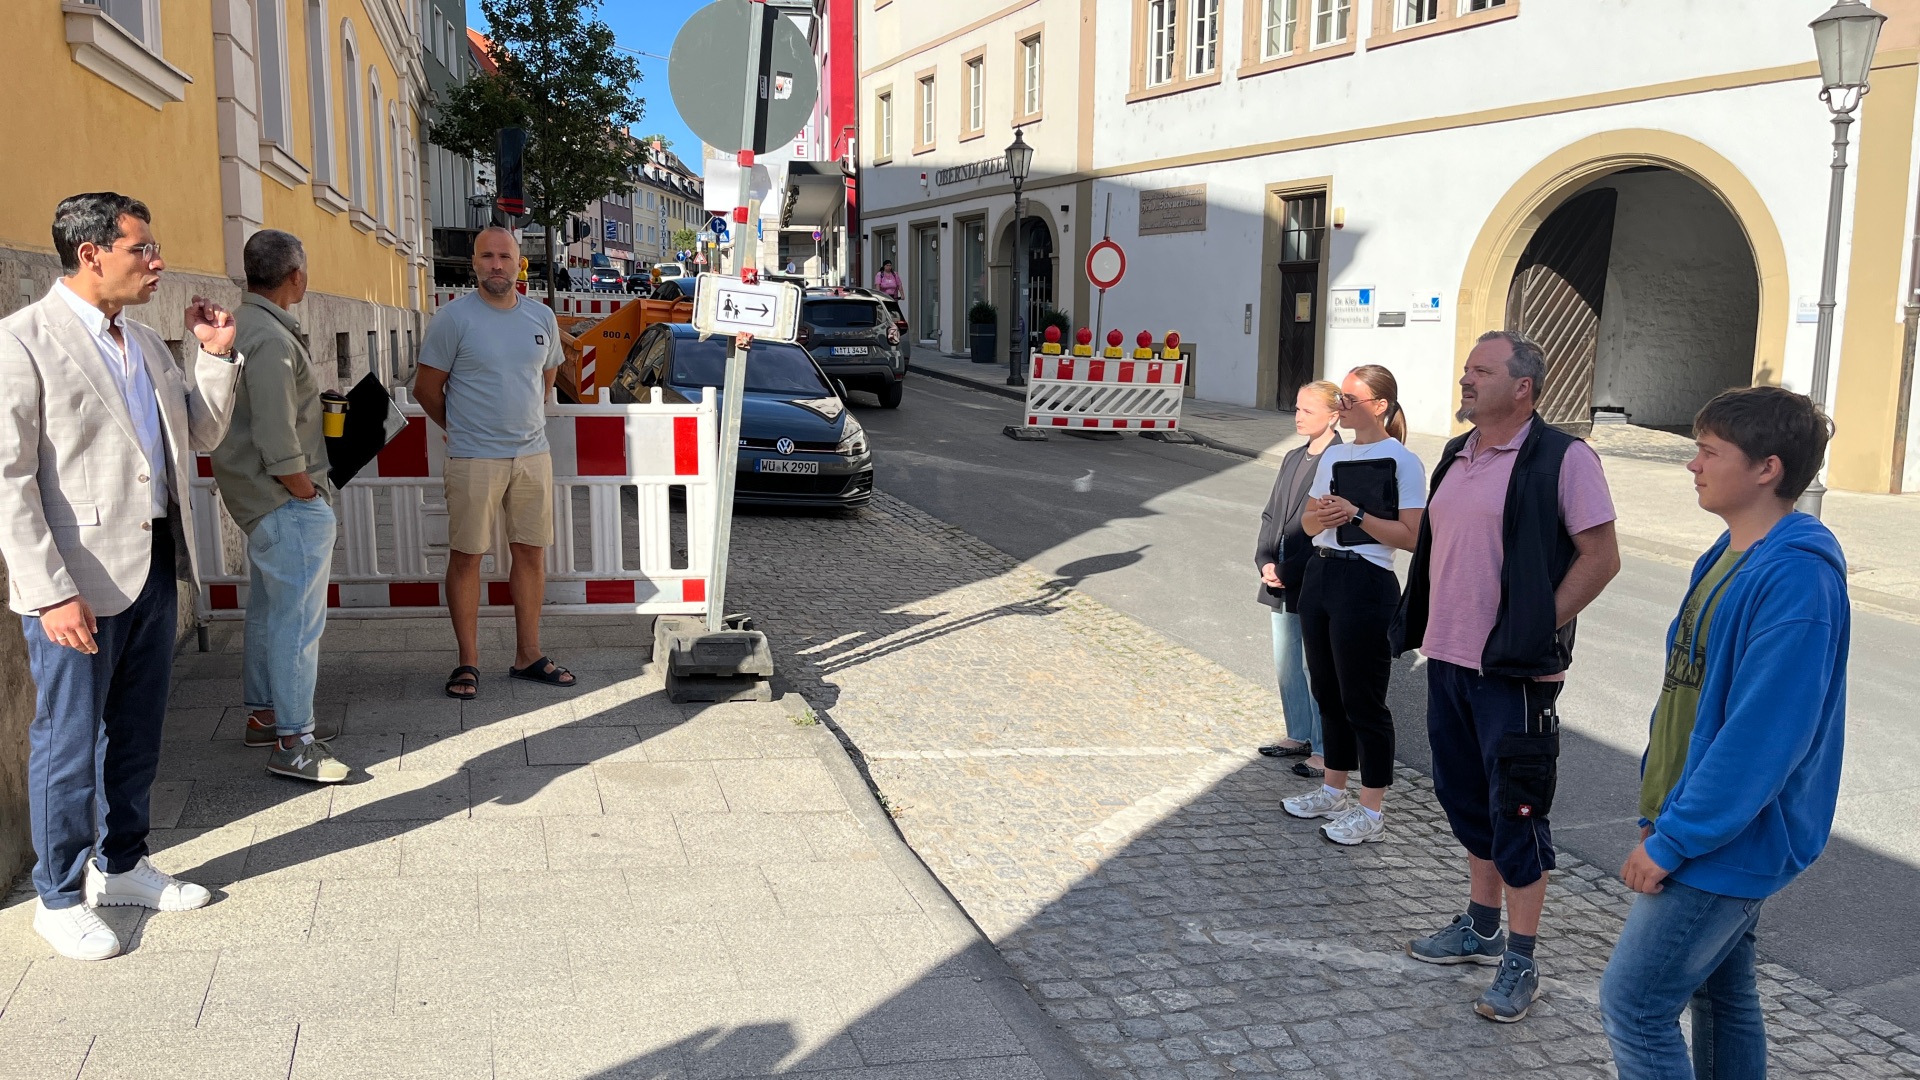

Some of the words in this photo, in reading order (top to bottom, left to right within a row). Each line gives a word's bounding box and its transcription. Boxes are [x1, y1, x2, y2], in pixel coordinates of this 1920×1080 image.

[761, 460, 776, 471] WÜ
[782, 461, 789, 472] K
[791, 462, 817, 474] 2990
